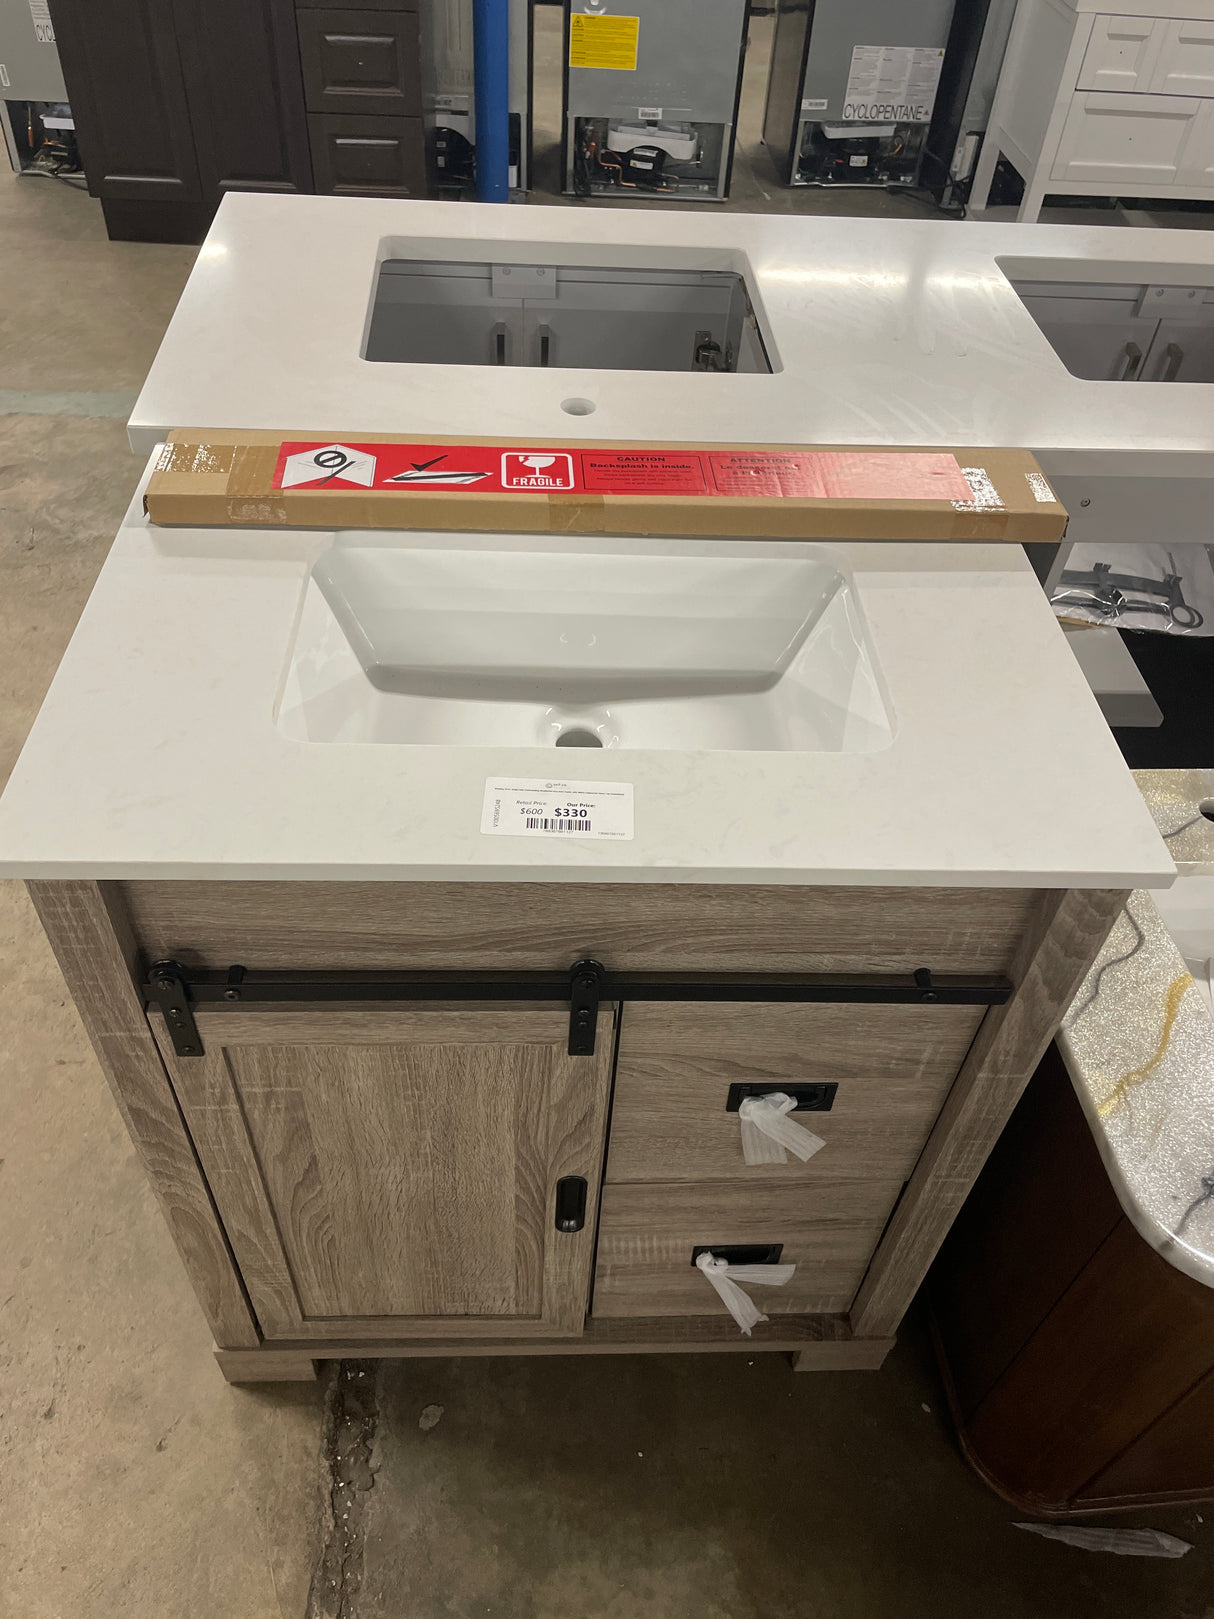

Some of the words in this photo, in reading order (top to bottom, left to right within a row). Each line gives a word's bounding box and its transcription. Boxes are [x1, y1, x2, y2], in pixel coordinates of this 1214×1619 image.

[843, 103, 924, 121] CYCLOPENTANE
[512, 477, 563, 487] FRAGILE
[554, 807, 588, 818] $330
